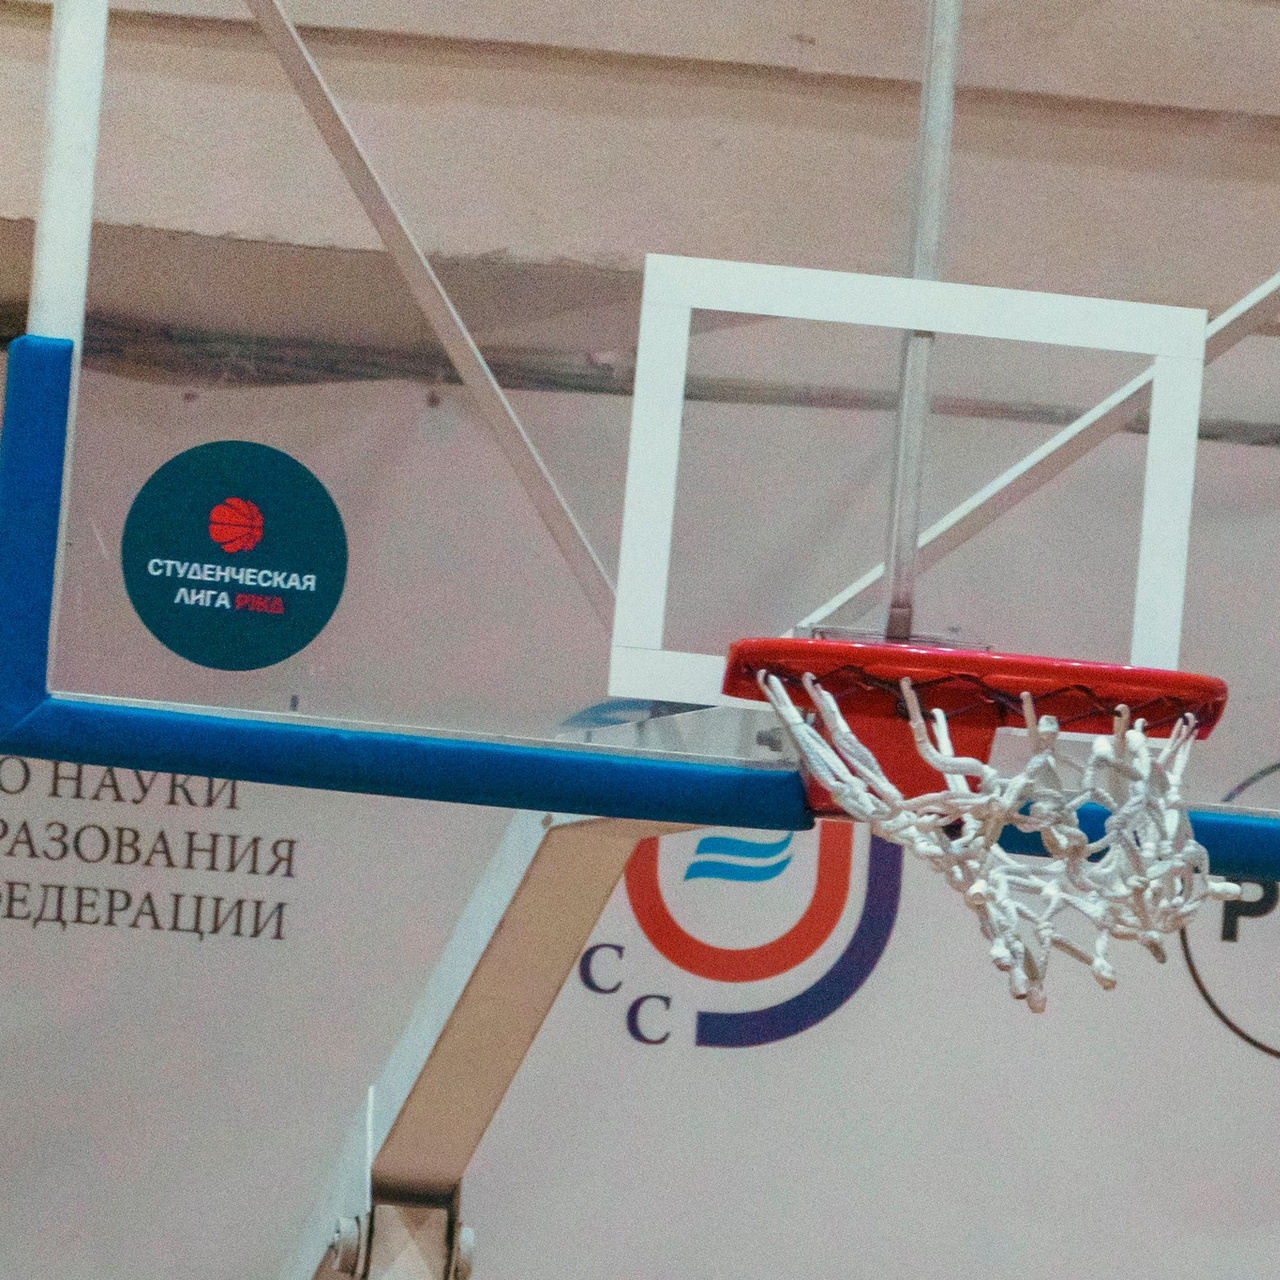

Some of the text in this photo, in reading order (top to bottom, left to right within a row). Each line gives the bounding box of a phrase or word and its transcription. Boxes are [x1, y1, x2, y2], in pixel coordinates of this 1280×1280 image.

[147, 558, 317, 592] СТУДЕНЧЕСКАЯ
[174, 587, 231, 609] ЛИГА
[49, 760, 240, 810] НАУКИ
